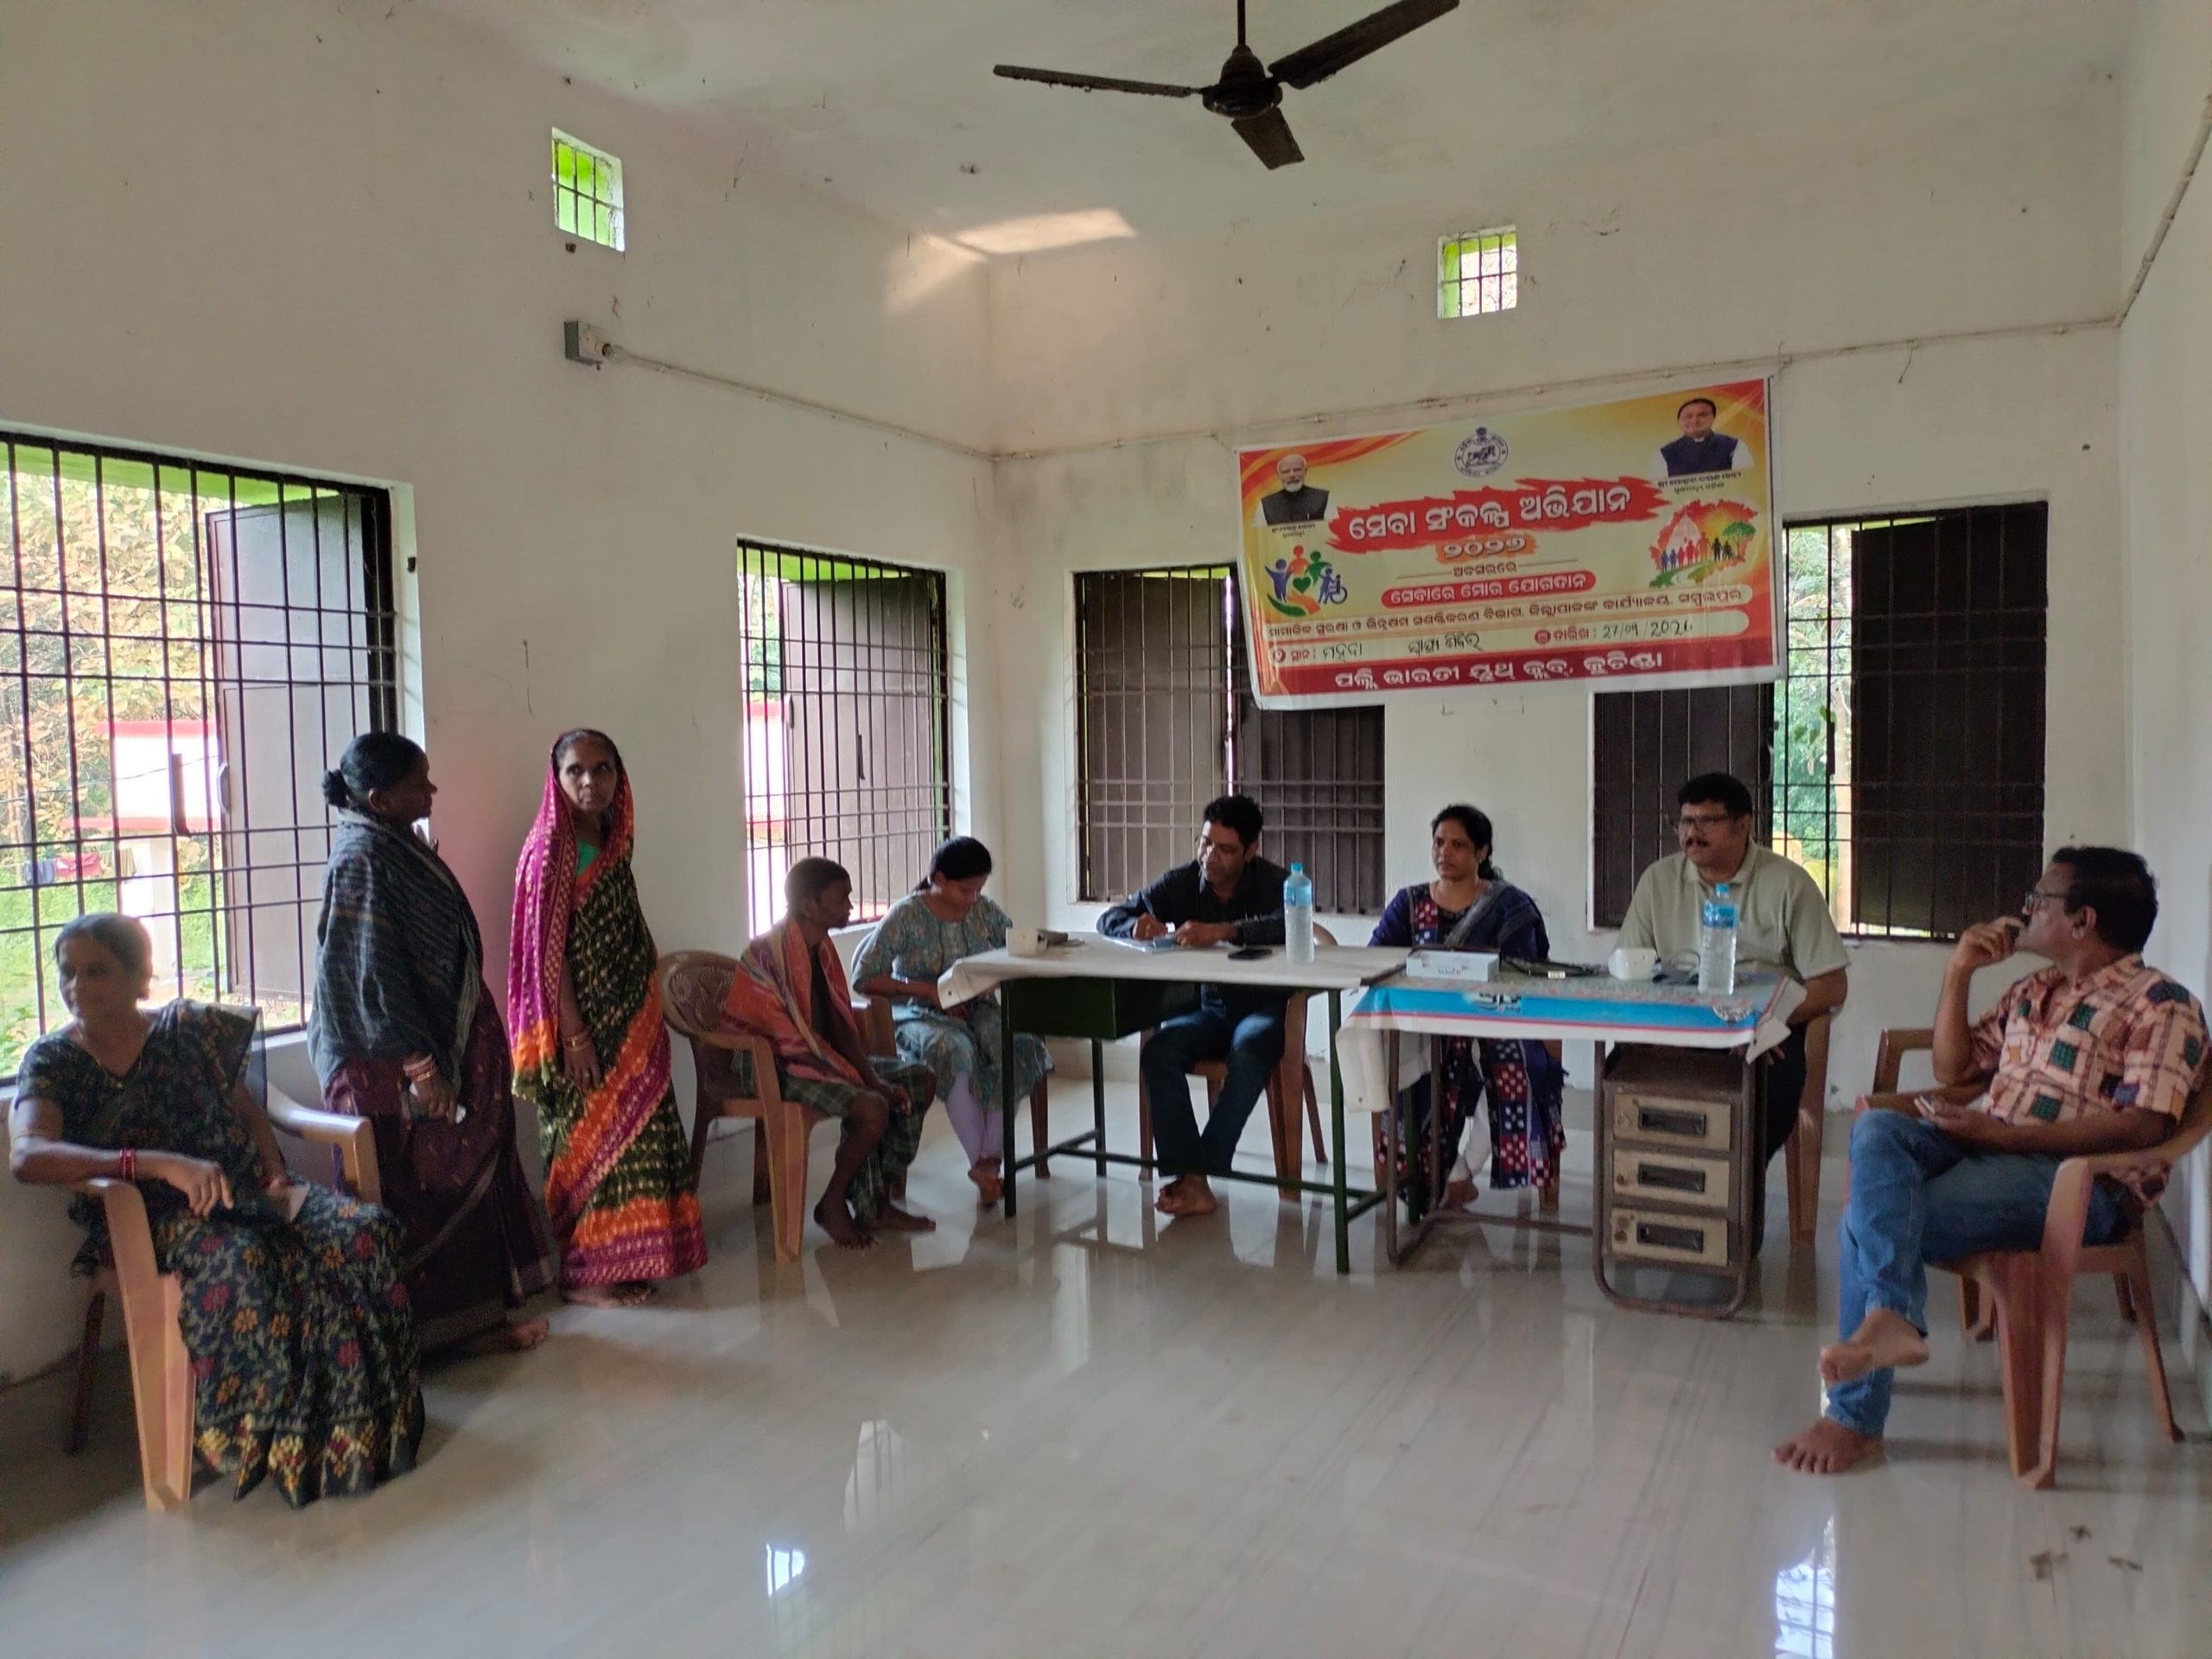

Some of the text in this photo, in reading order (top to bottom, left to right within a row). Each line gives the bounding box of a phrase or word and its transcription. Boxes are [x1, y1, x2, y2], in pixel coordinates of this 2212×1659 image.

[1349, 484, 1631, 540] ସେବା ସଂକଳ୍ପ ଅଭିଯାନ
[1443, 536, 1527, 559] ୨୦୨୬
[1452, 561, 1517, 577] ଅବସରରେ
[1390, 573, 1586, 605] ସେବାରେ ମୋର ଯୋଗଦାନ
[1268, 624, 1312, 637] ସାମାଜିକ
[1315, 621, 1348, 636] ସୁରକ୍ଷା
[1351, 620, 1362, 631] ଓ
[1553, 625, 1590, 641] ତାରିଖ
[1383, 664, 1460, 686] ଭାରତୀ
[1583, 650, 1662, 676] କୁଚିଣ୍ଡା
